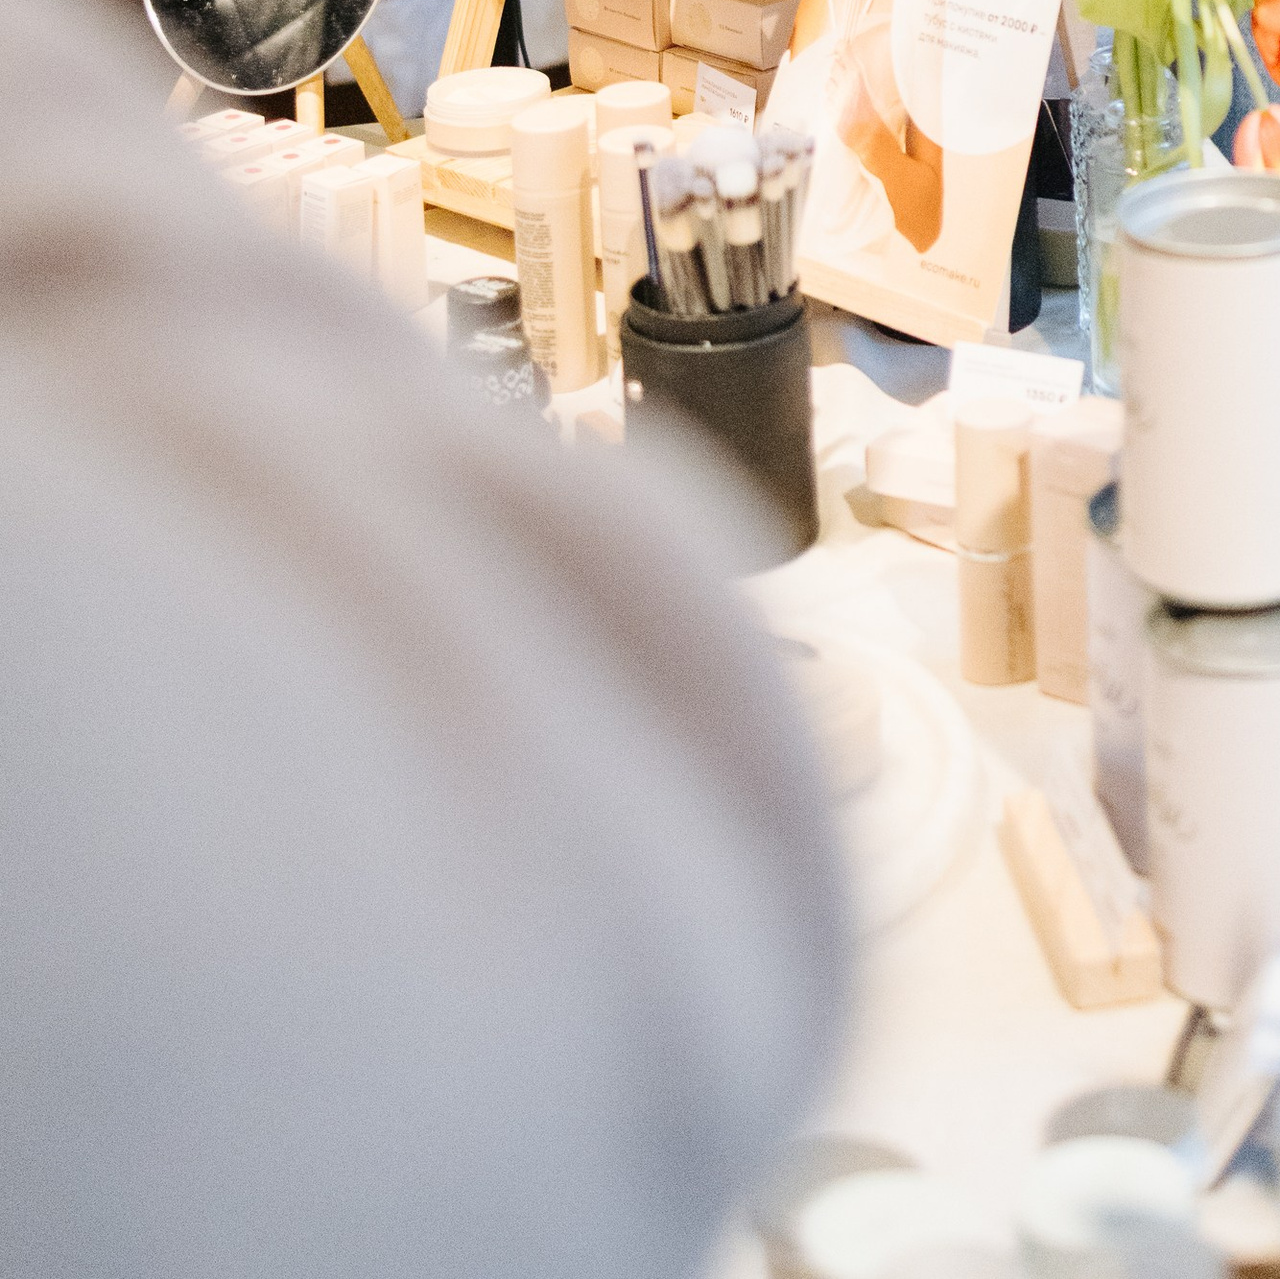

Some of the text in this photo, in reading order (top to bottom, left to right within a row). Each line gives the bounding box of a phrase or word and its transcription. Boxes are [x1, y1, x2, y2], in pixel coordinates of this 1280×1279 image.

[987, 13, 1000, 23] от
[1000, 14, 1028, 34] 2000
[729, 107, 744, 122] 1610
[920, 259, 981, 289] ecomake.ru
